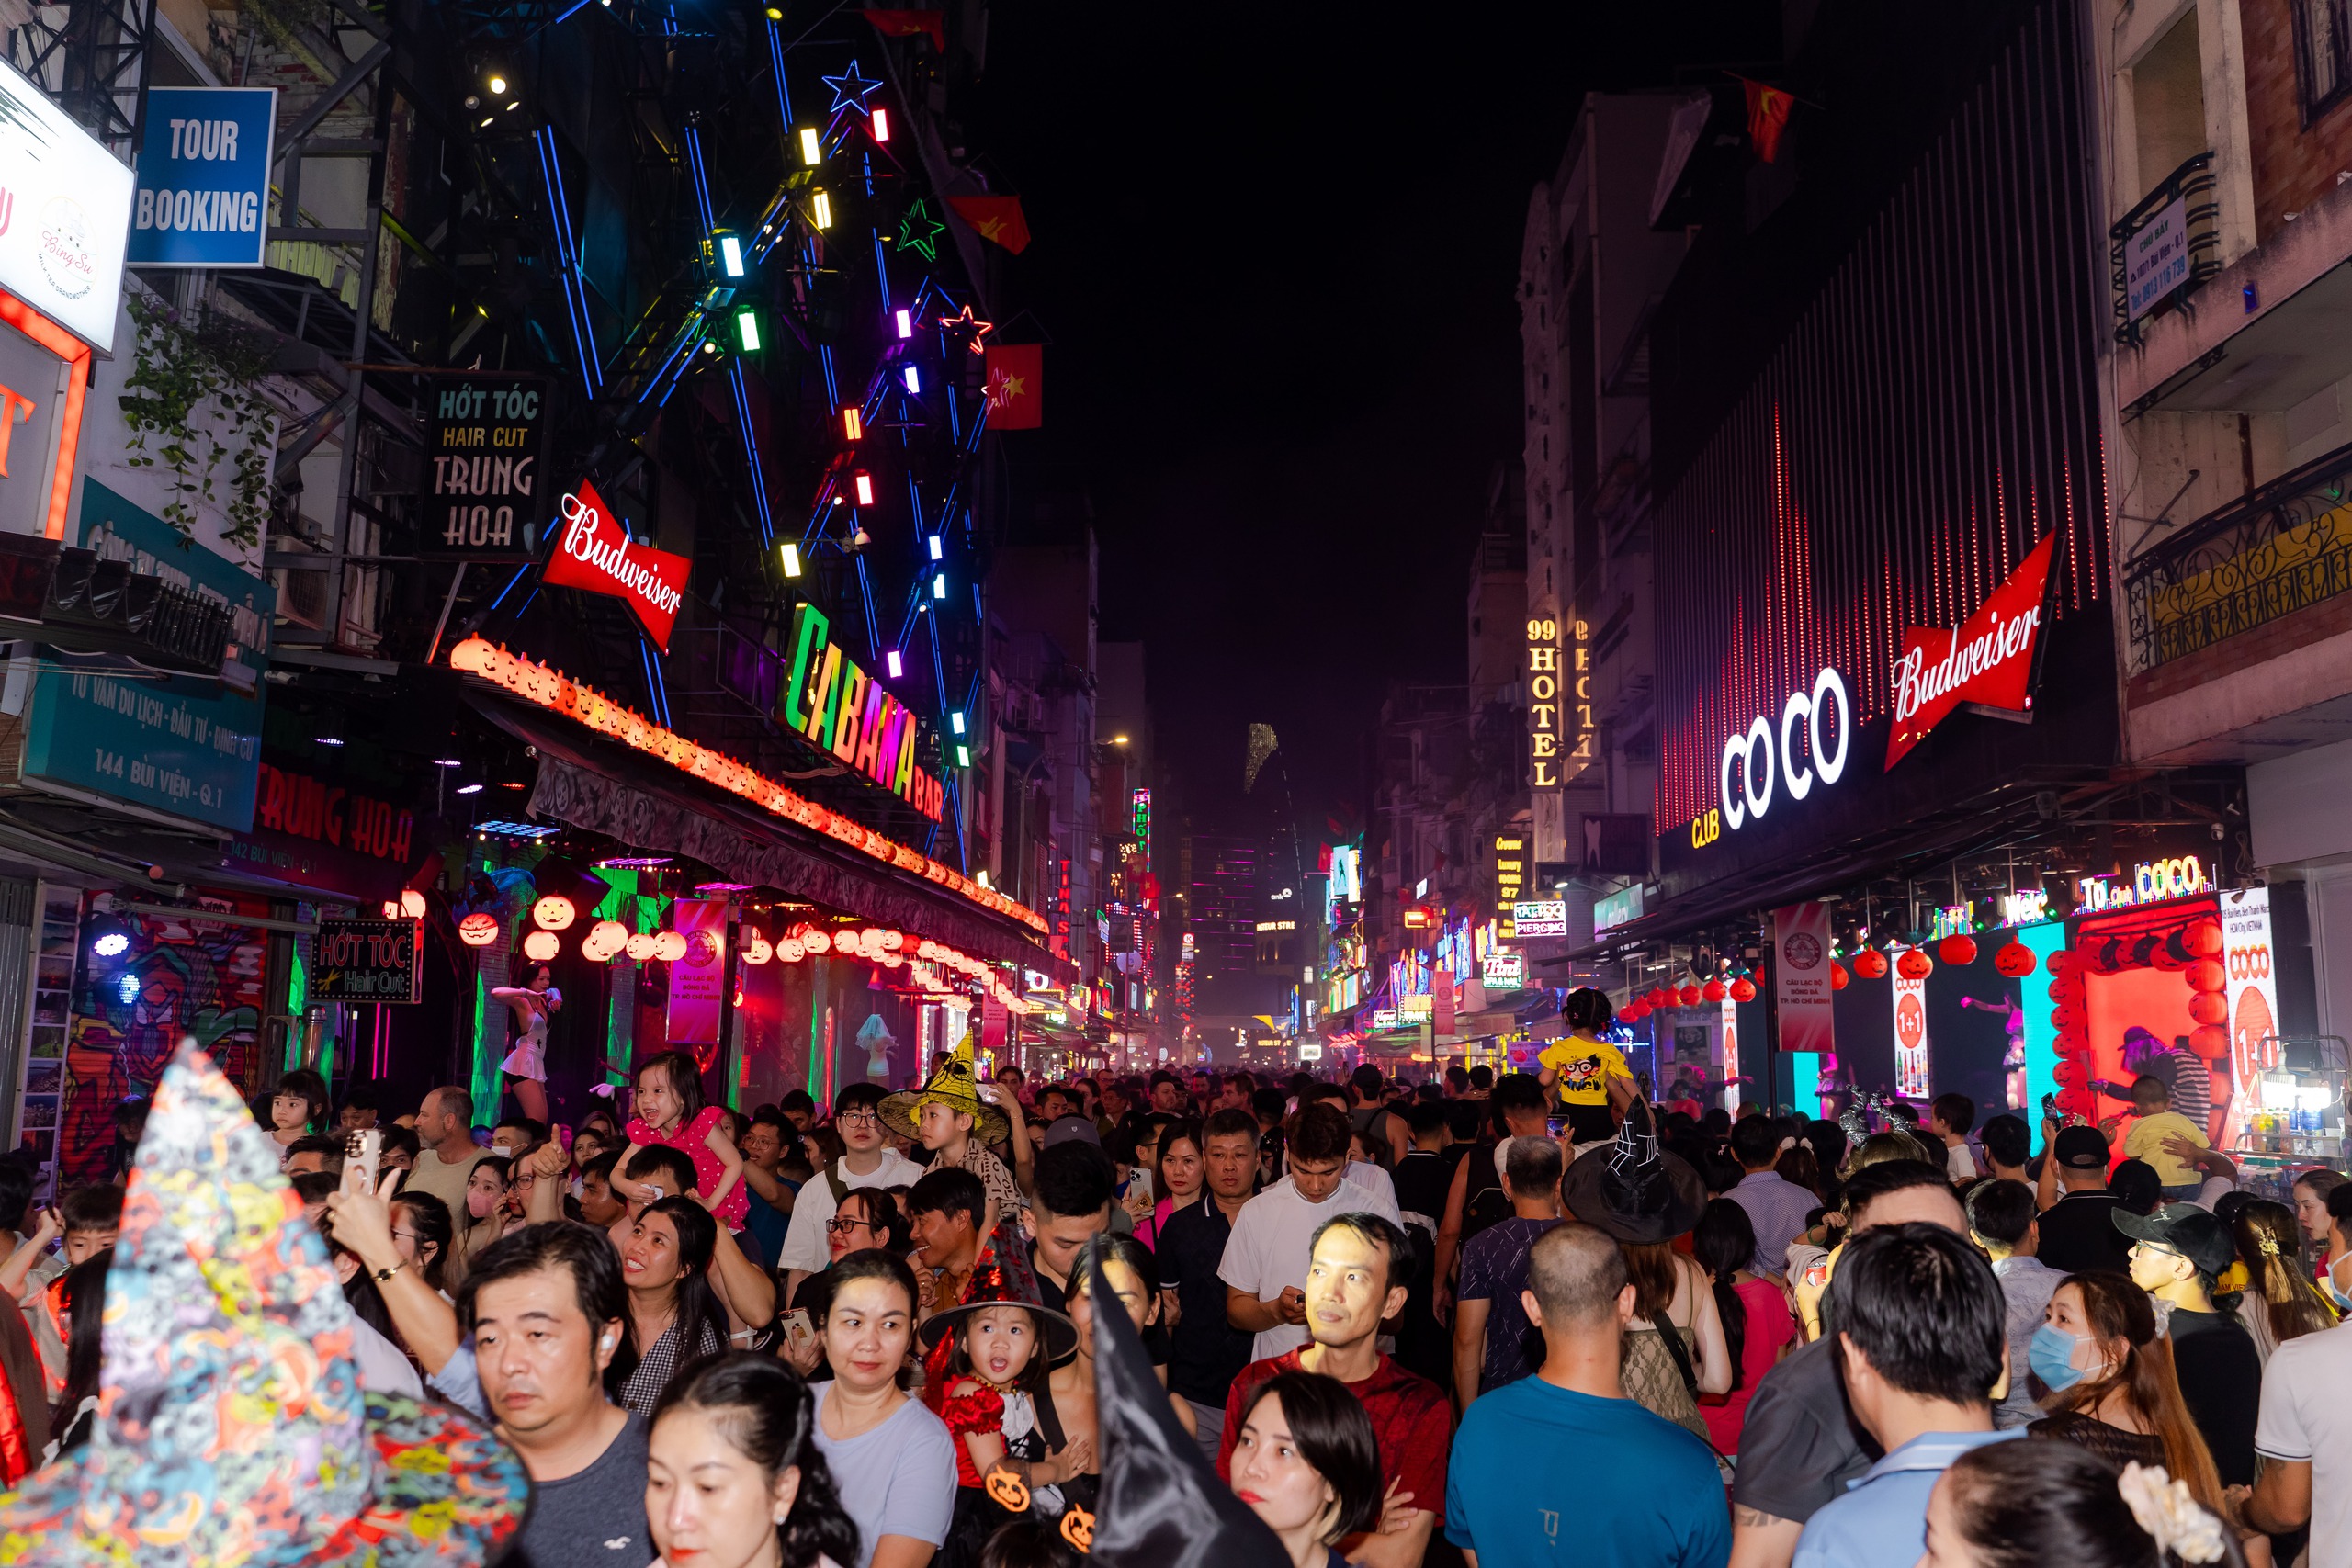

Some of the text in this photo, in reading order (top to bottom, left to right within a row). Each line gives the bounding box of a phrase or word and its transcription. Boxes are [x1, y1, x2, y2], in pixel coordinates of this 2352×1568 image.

[170, 119, 237, 161] TOUR
[136, 189, 257, 233] BOOKING
[2175, 231, 2184, 249] Q.1
[38, 253, 91, 299] MILK TEA GRANDMOTHER
[2143, 276, 2158, 303] 0913
[2159, 266, 2171, 289] 116
[2172, 255, 2186, 279] 739
[438, 383, 539, 420] HỚT TÓC
[443, 427, 528, 446] HAIR CUT
[434, 455, 534, 496] TRUNG
[442, 505, 514, 546] HOA
[561, 493, 681, 615] Budweiser
[1527, 620, 1556, 641] 99
[1891, 604, 2041, 723] Budweiser
[118, 686, 135, 717] DU
[138, 694, 164, 729] LỊCH
[170, 700, 191, 739] ĐẦU
[195, 716, 209, 744] TƯ
[213, 725, 237, 758] ĐỊNH
[785, 602, 944, 823] CABANA BAR
[1529, 648, 1556, 787] HOTEL
[1722, 668, 1849, 830] COCO
[96, 748, 124, 778] 144
[130, 754, 155, 788] BÙI
[160, 768, 191, 803] VIỆN
[200, 783, 222, 808] Q.1
[255, 761, 413, 863] TRUNG HOA
[1692, 807, 1720, 850] CLUB
[231, 840, 247, 859] 142
[250, 843, 268, 863] BÙI
[1501, 886, 1519, 898] 97
[2081, 878, 2106, 909] To
[2137, 855, 2199, 899] COCO
[1057, 860, 1070, 961] TINA SPA
[1516, 904, 1565, 919] TATTOO
[1517, 921, 1565, 934] PIERCING
[2246, 920, 2262, 931] VIETNAM
[2248, 905, 2259, 915] Thanh
[321, 927, 406, 967] HỚT TÓC
[345, 970, 404, 993] Hair Cut
[1899, 1010, 1921, 1033] 1+1
